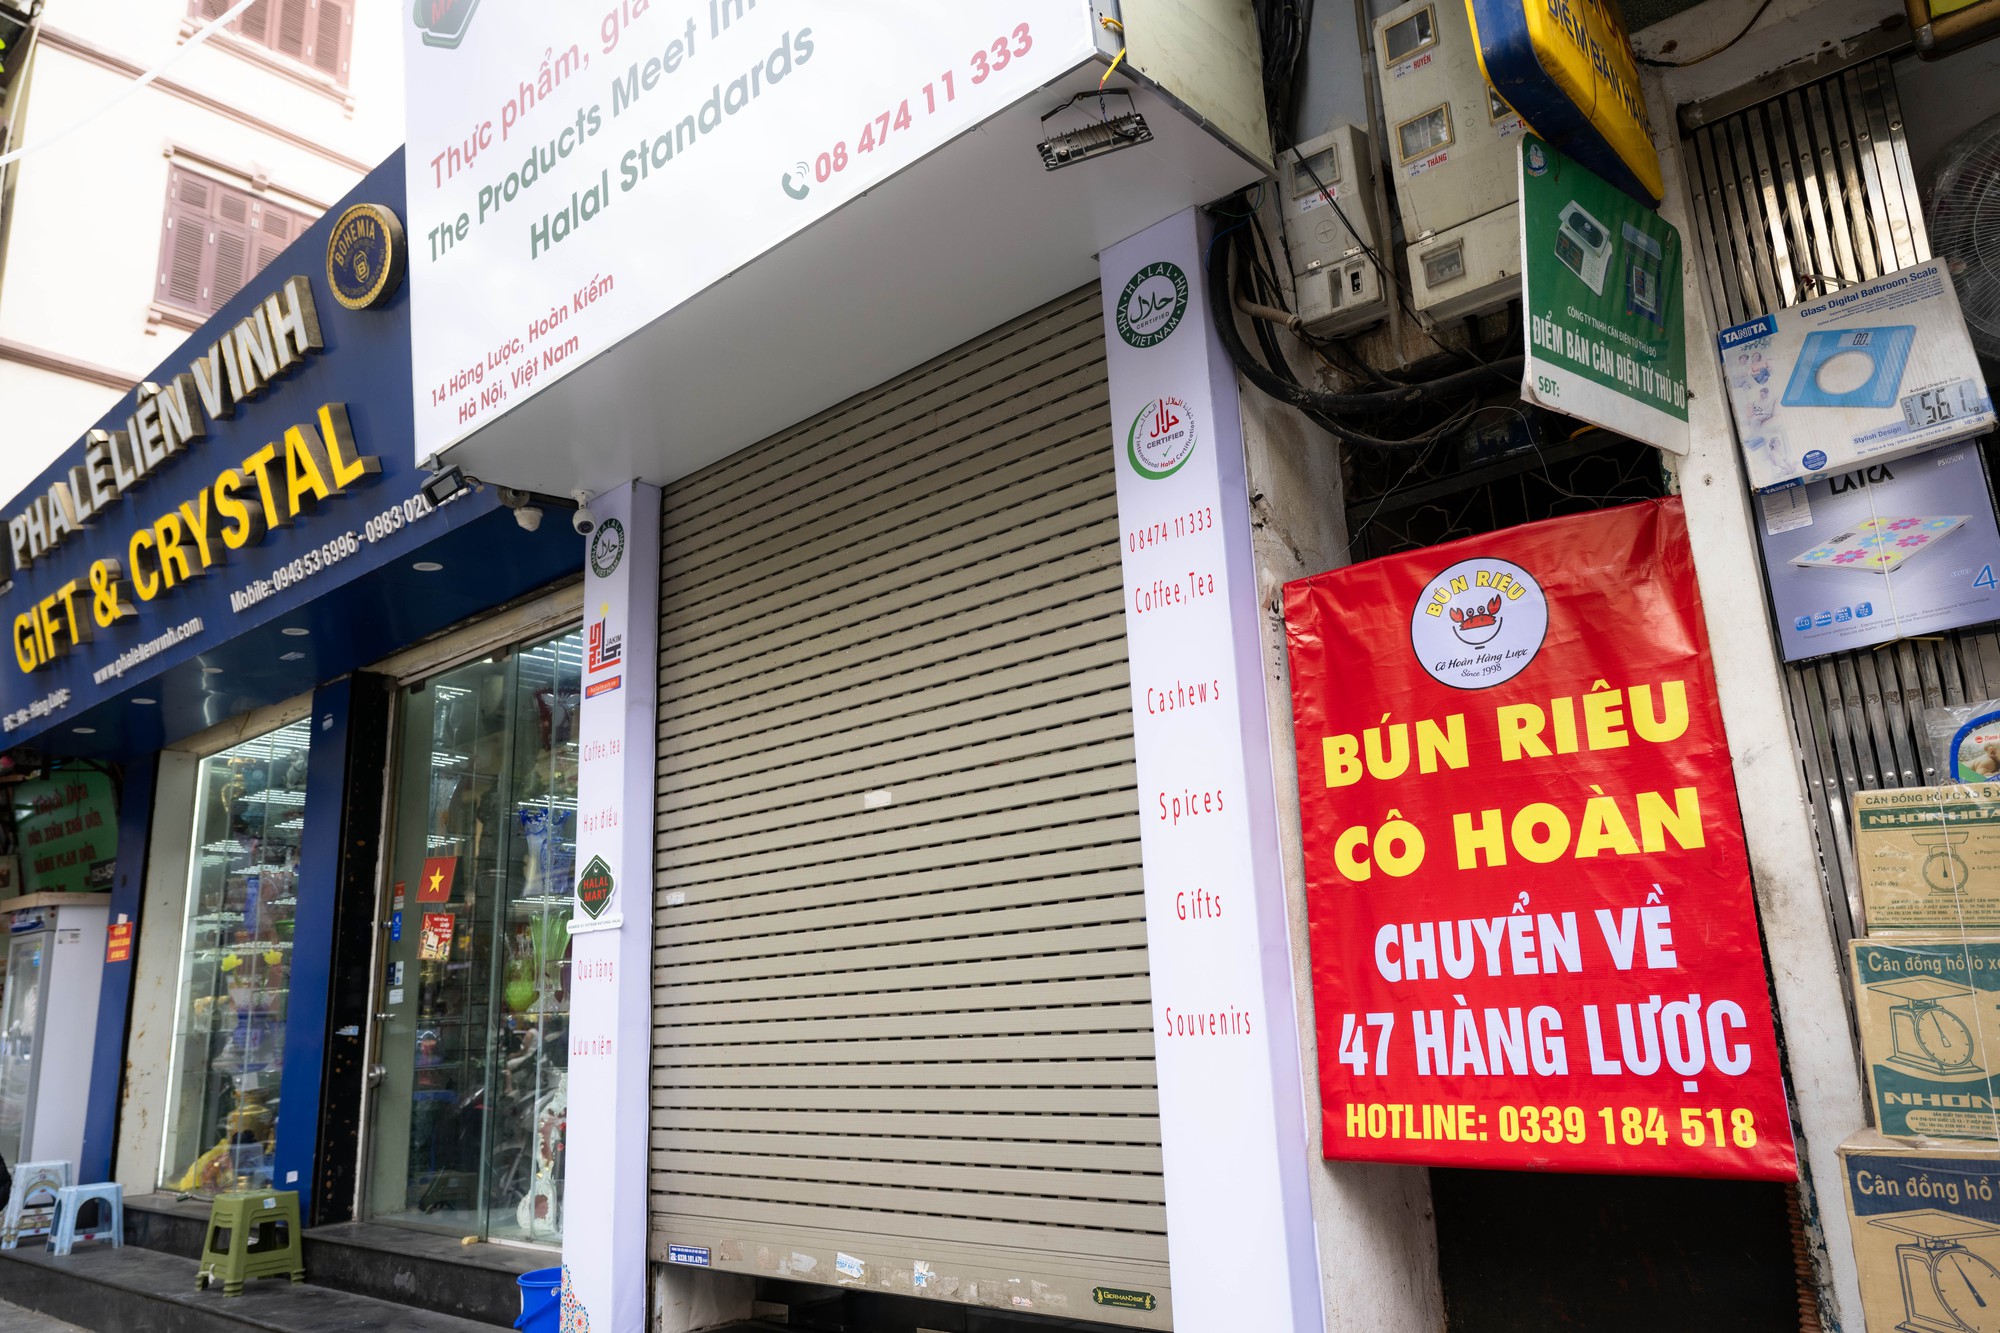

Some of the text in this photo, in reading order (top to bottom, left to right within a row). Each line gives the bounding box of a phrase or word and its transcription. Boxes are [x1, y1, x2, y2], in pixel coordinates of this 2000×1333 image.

[431, 119, 493, 190] Thực
[502, 47, 590, 142] phẩm,
[815, 22, 1033, 183] 08 474 11 333
[428, 16, 697, 263] The Products Meet
[530, 26, 815, 260] Halal Standards
[335, 219, 375, 267] BOHEMIA
[1125, 263, 1172, 295] HALAL
[1800, 303, 1827, 318] Glass
[1828, 292, 1859, 311] Digital
[1861, 277, 1908, 298] Bathroom
[1909, 265, 1938, 281] Scale
[1136, 311, 1170, 330] CERTIFIED
[1154, 317, 1180, 343] NAM
[1567, 306, 1584, 322] CÔNG
[1583, 312, 1592, 326] TY
[1592, 317, 1607, 334] TNHH
[1607, 325, 1619, 339] CÂN
[1723, 321, 1768, 344] TANITA
[190, 275, 312, 420] VINH
[431, 273, 614, 408] 14 Hàng Lược, Hoàn Kiếm
[1532, 310, 1686, 410] ĐIỂM BÁN CÂN ĐIỆN TỬ THỦ ĐÔ
[459, 335, 579, 425] Hà Nội, Việt Nam
[1539, 374, 1560, 398] SĐT:
[1150, 399, 1180, 438] حلال
[1969, 405, 1980, 414] kg
[1136, 419, 1195, 469] International Halal Certification
[1146, 430, 1185, 450] CERTIFIED
[1853, 432, 1877, 446] Stylish
[1878, 426, 1902, 438] Design
[1765, 482, 1797, 494] TANITA
[14, 404, 366, 674] GIFT & CRYSTAL
[230, 578, 272, 613] Mobile:
[273, 557, 305, 592] 0943
[304, 549, 322, 575] 53
[321, 531, 358, 566] 6996
[365, 505, 402, 544] 0983
[1425, 571, 1526, 617] BÚN RIÊU
[1973, 564, 1999, 590] 4
[606, 634, 622, 647] JAKIM
[1797, 619, 1810, 628] LCD
[1435, 648, 1529, 672] Cô Hoàn Hàng Lược
[1461, 663, 1502, 677] Since 1998
[1147, 679, 1219, 715] Cashews
[1322, 679, 1690, 789] BÚN RIÊU
[1159, 788, 1224, 826] Spices
[1983, 786, 1992, 798] 5
[1333, 784, 1706, 882] CÔ HOÀN
[583, 876, 609, 890] HALAL
[583, 888, 607, 902] MART
[1176, 888, 1222, 921] Gifts
[1374, 883, 1678, 983] CHUYỂN VỀ
[1867, 951, 1901, 972] Cân
[1905, 953, 1942, 975] đồng
[1945, 953, 1966, 971] hồ
[1166, 1005, 1251, 1037] Souvenirs
[1338, 994, 1752, 1093] 47 HÀNG LƯỢC
[1884, 1092, 2000, 1109] NHƠN
[1346, 1103, 1757, 1149] HOTLINE: 0339 184 518
[1856, 1170, 1993, 1205] Cân đồng hồ
